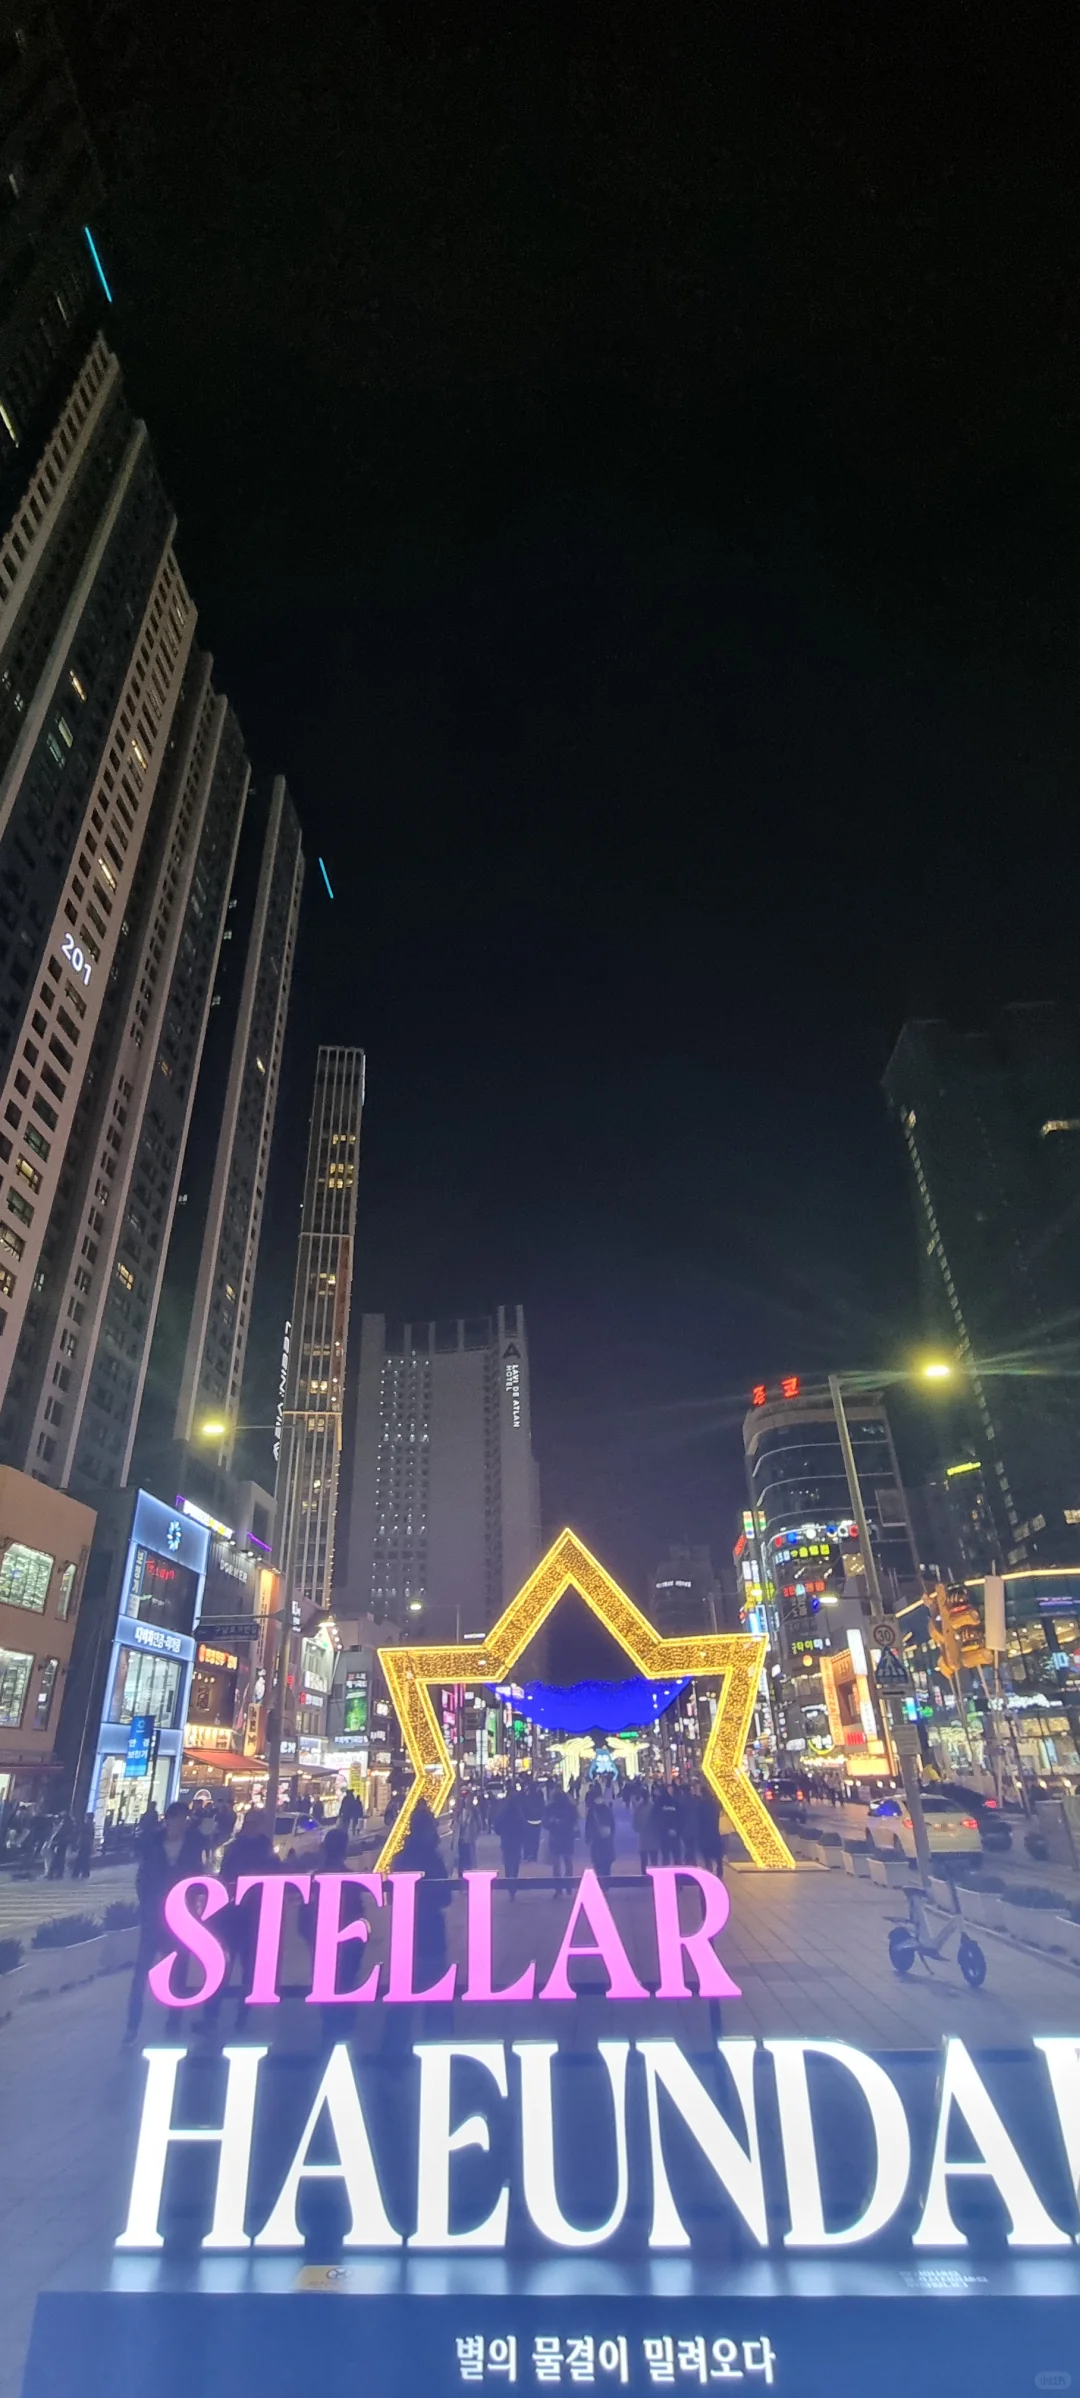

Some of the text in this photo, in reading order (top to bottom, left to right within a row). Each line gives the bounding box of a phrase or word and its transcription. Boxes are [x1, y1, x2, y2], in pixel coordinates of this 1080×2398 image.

[61, 933, 92, 985] 201
[505, 1365, 513, 1391] HOTEL
[512, 1386, 520, 1397] DE
[513, 1400, 521, 1428] ATLAN
[878, 1629, 891, 1642] 30
[148, 1866, 742, 2007] STELLAR
[114, 2037, 1080, 2248] HAEUNDA
[455, 2335, 777, 2383] 별의 물결이 밀려오다
